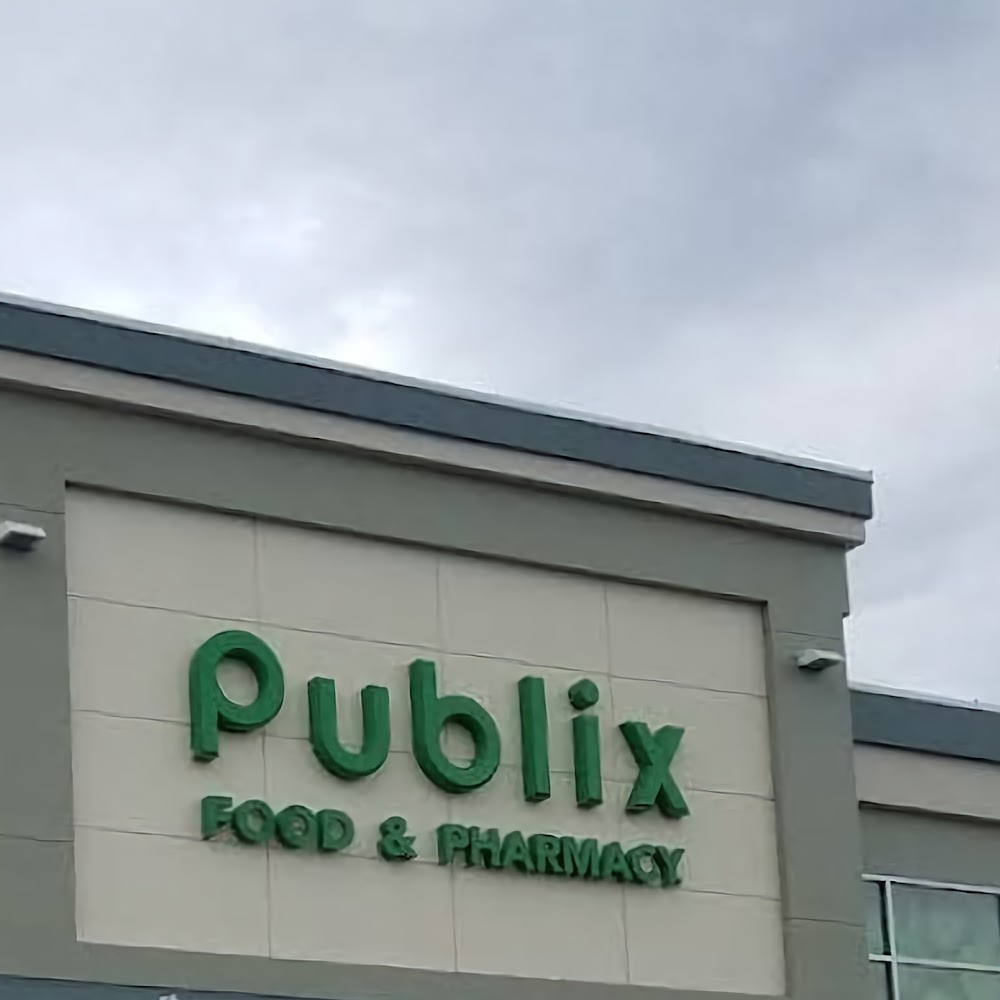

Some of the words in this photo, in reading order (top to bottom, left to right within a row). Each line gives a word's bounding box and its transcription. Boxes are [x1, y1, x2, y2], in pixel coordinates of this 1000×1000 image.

[189, 630, 690, 819] Publix
[201, 796, 355, 852] FOOD
[377, 816, 417, 861] &
[437, 823, 685, 887] PHARMACY
